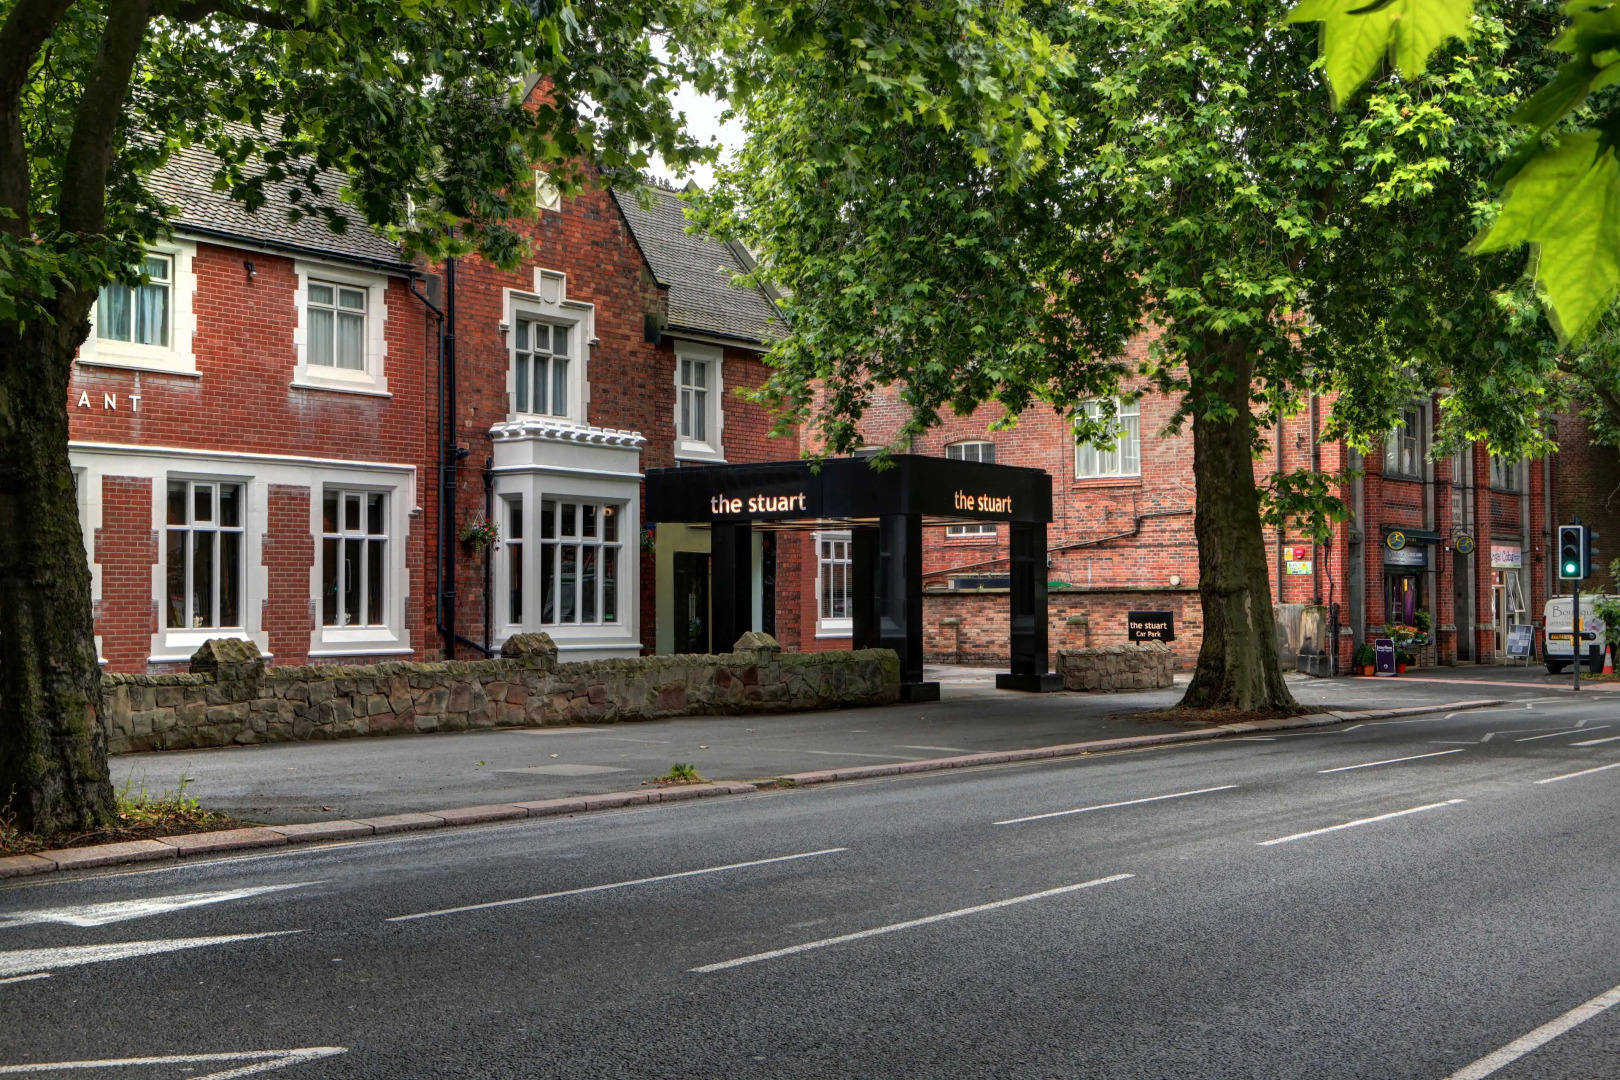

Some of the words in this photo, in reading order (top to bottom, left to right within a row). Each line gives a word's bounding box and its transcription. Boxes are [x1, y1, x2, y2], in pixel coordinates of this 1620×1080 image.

[711, 493, 743, 514] the
[748, 492, 807, 512] stuart
[954, 489, 975, 511] the
[977, 493, 1012, 513] stuart
[1130, 621, 1143, 629] the
[1145, 621, 1167, 629] stuart
